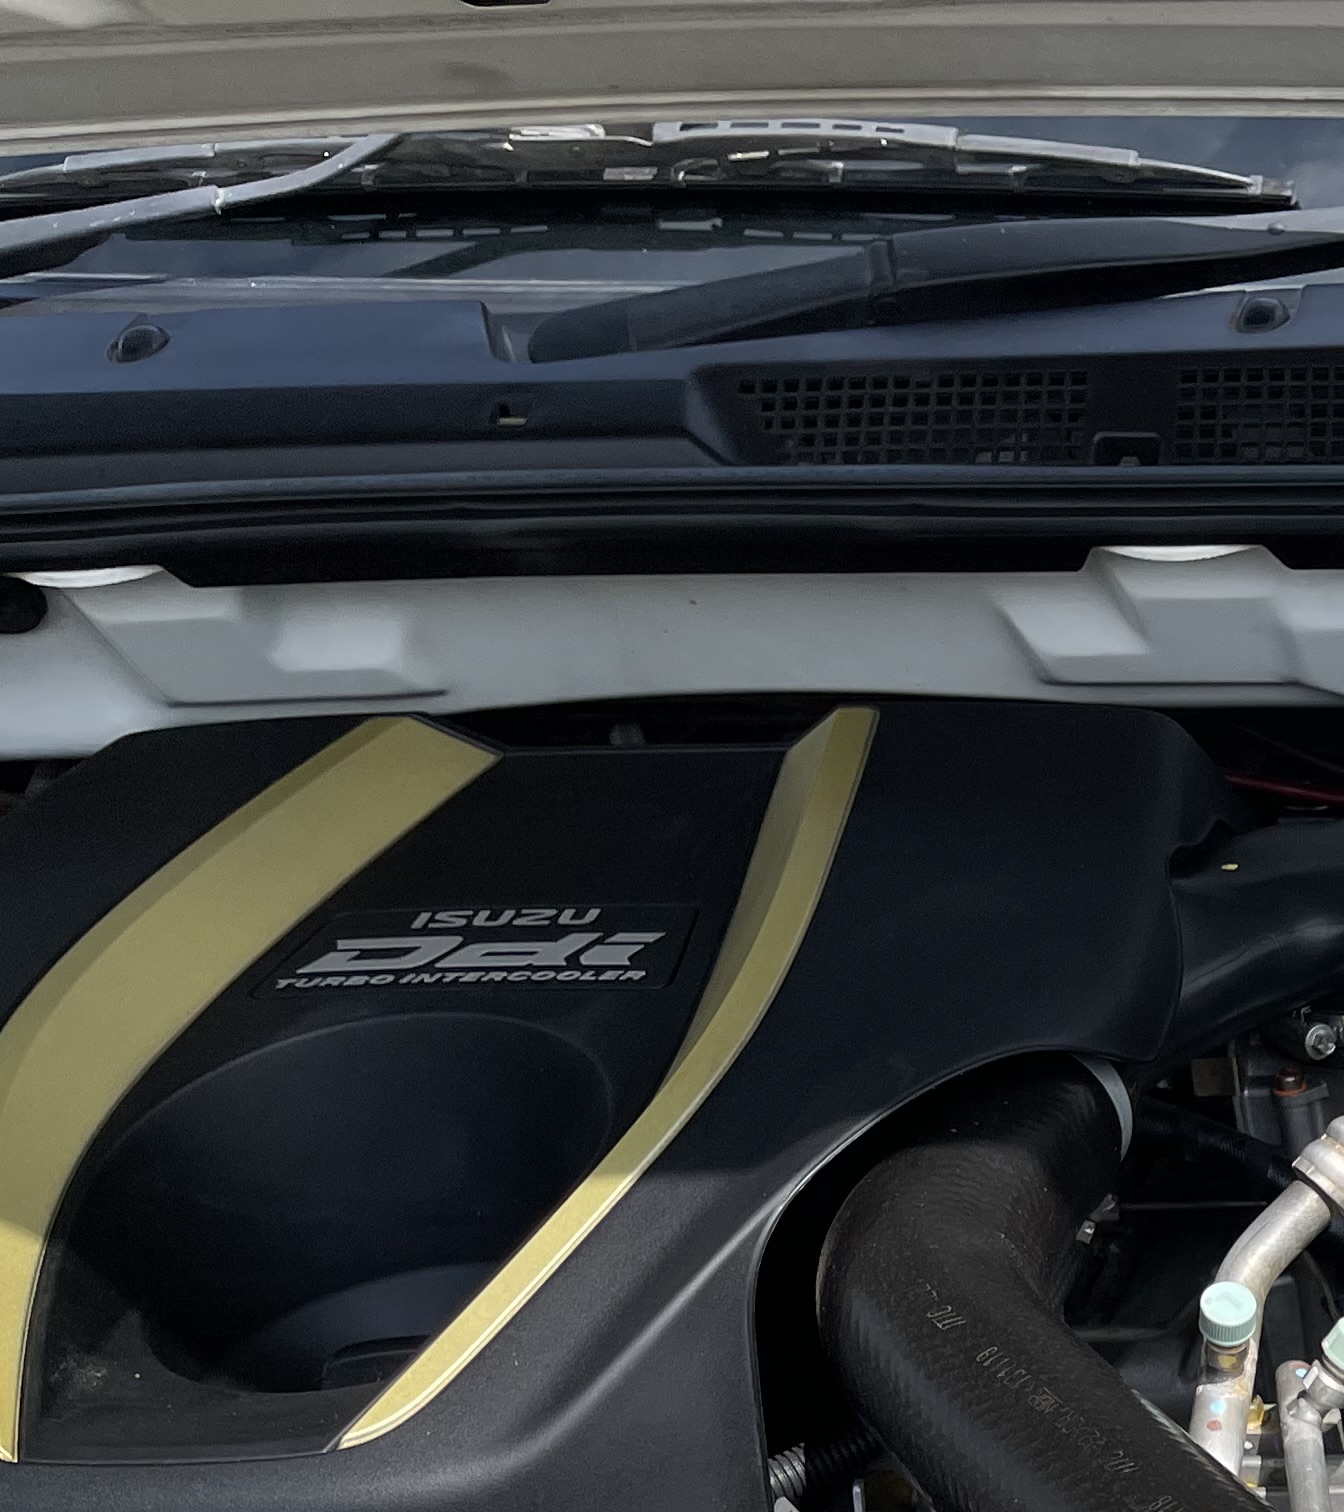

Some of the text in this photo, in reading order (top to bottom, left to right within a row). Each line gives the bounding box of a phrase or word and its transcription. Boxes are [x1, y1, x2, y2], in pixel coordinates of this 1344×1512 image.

[410, 908, 601, 930] ISUZU
[275, 969, 647, 990] TURBO INTERCOOLER
